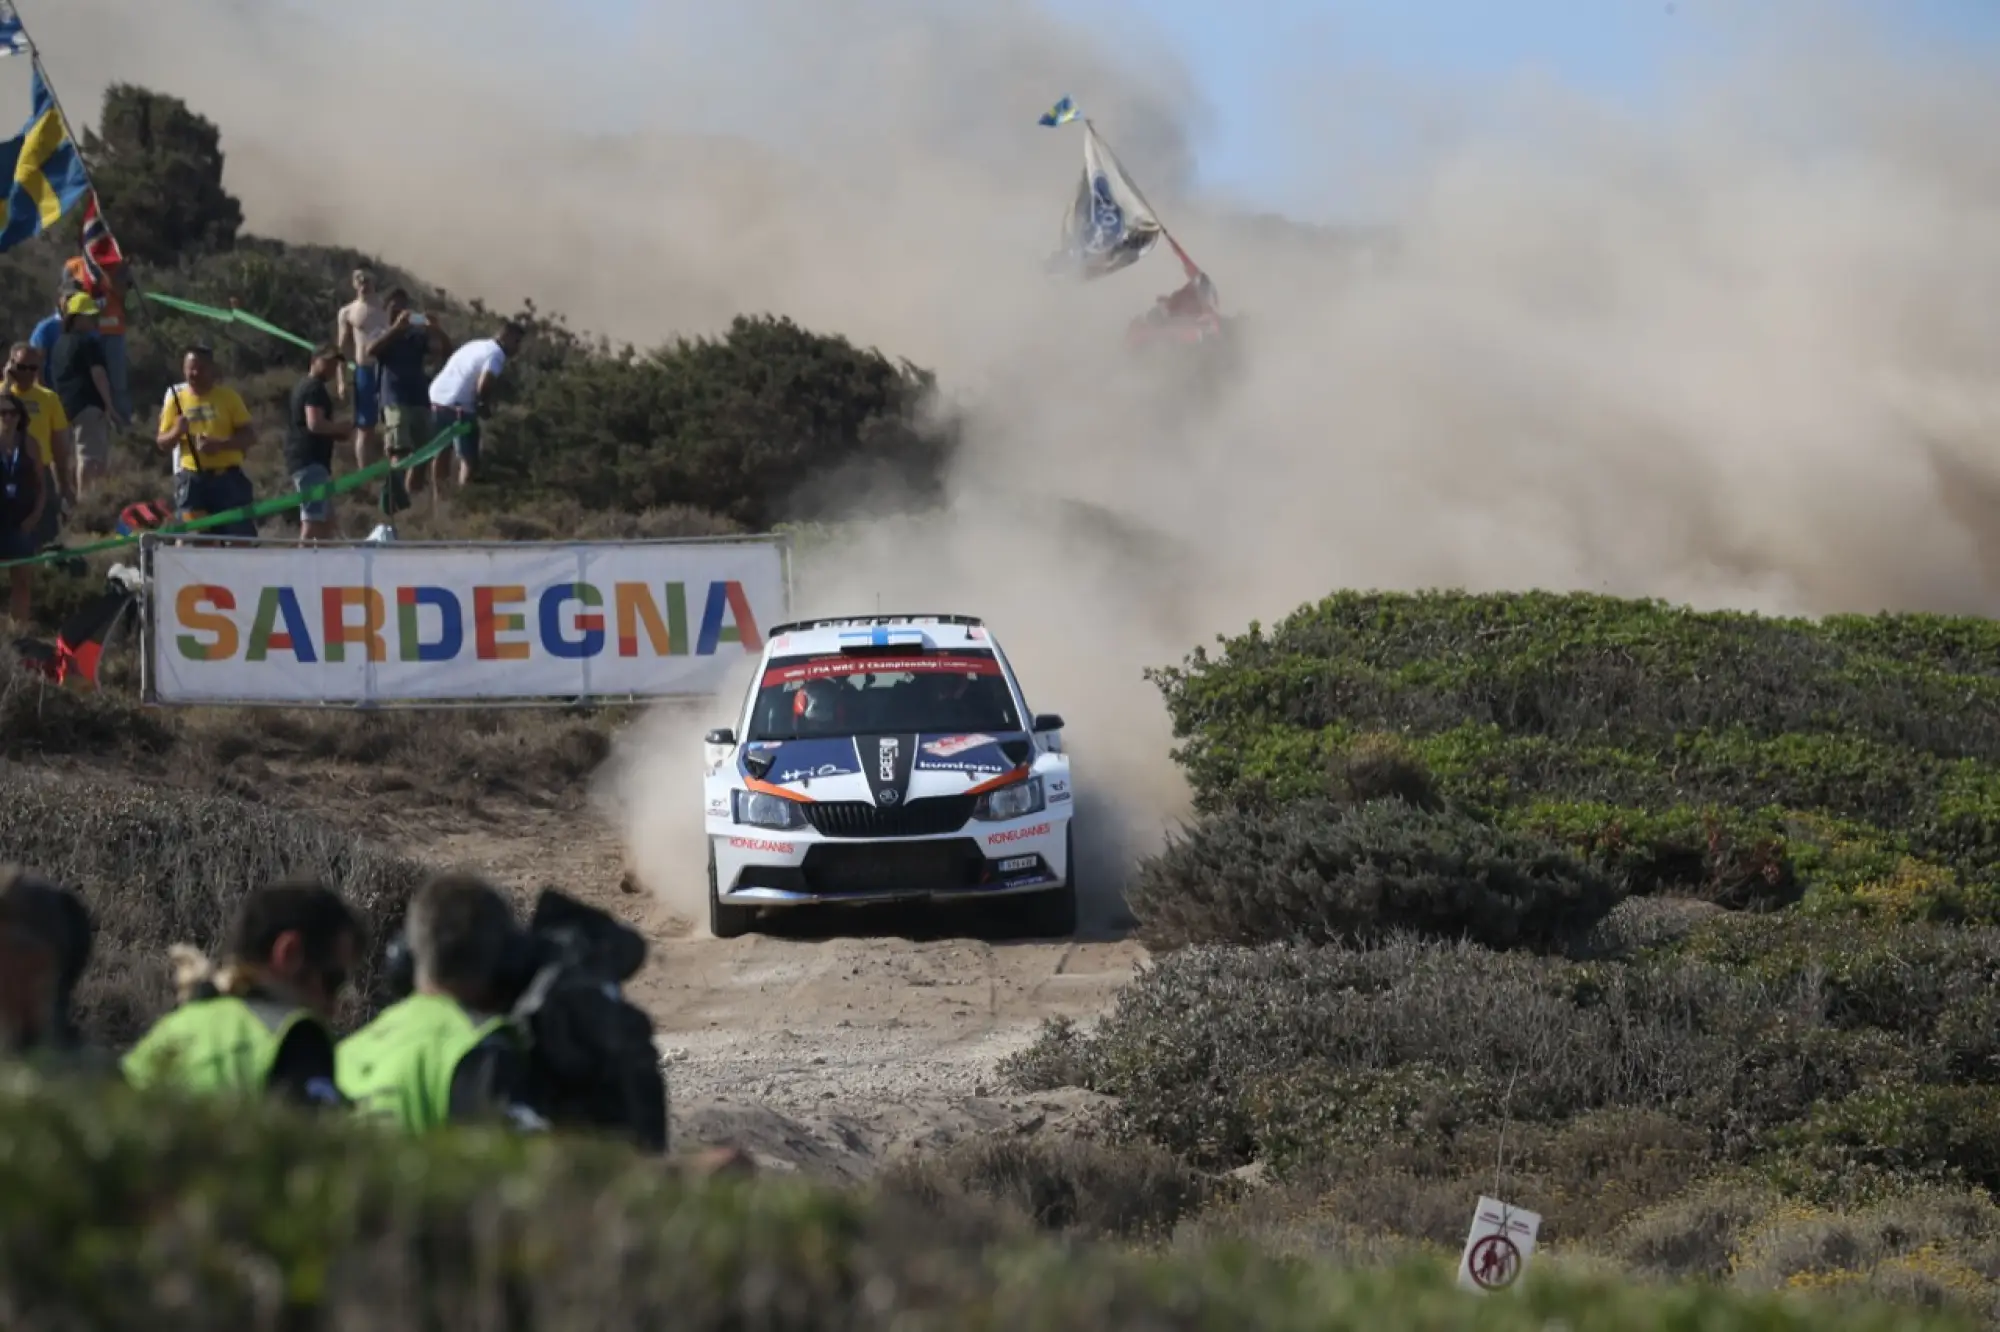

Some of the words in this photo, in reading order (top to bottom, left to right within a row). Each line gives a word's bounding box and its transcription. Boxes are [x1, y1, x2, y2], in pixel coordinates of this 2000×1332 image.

[174, 580, 764, 663] SARDEGNA
[867, 660, 937, 669] Championship
[987, 822, 1051, 845] KONECRANES
[729, 835, 795, 855] KONECRANES
